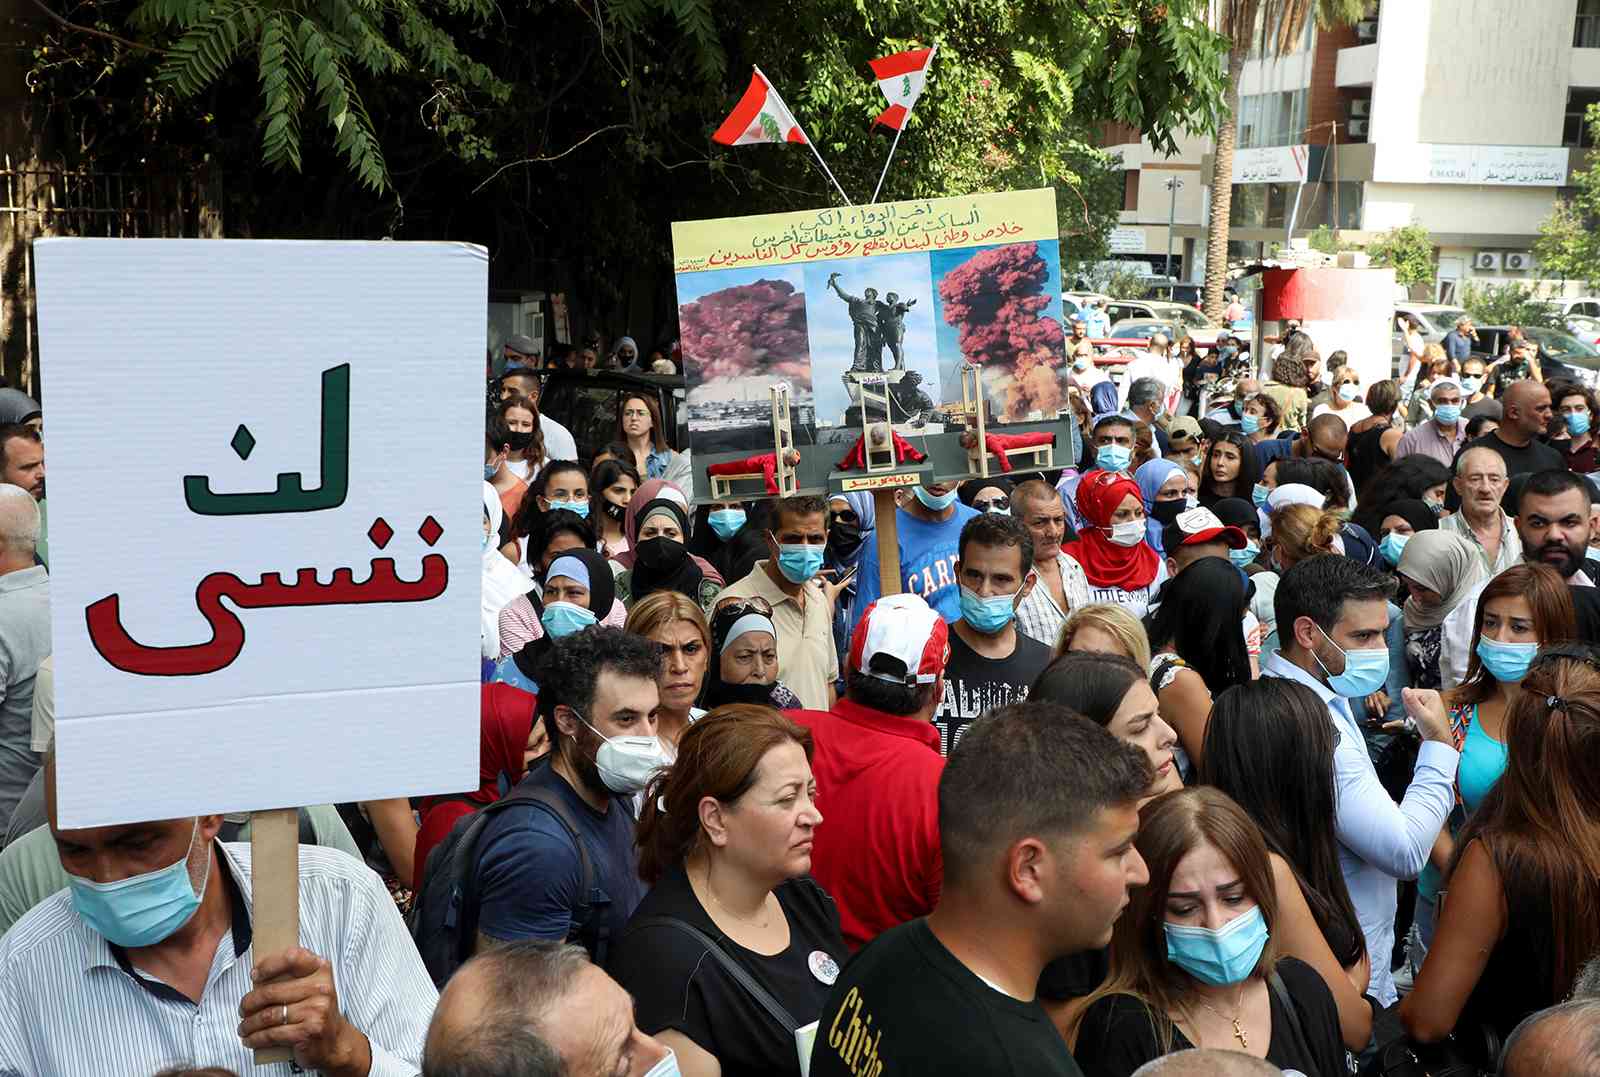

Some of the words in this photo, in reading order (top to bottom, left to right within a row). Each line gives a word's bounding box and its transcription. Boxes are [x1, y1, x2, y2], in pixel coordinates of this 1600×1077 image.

[896, 221, 919, 236] عن
[972, 221, 1024, 242] خلاص
[889, 232, 931, 251] لبنان
[709, 246, 778, 267] الفاسدين
[183, 362, 350, 516] لن
[85, 515, 449, 676] ننسى
